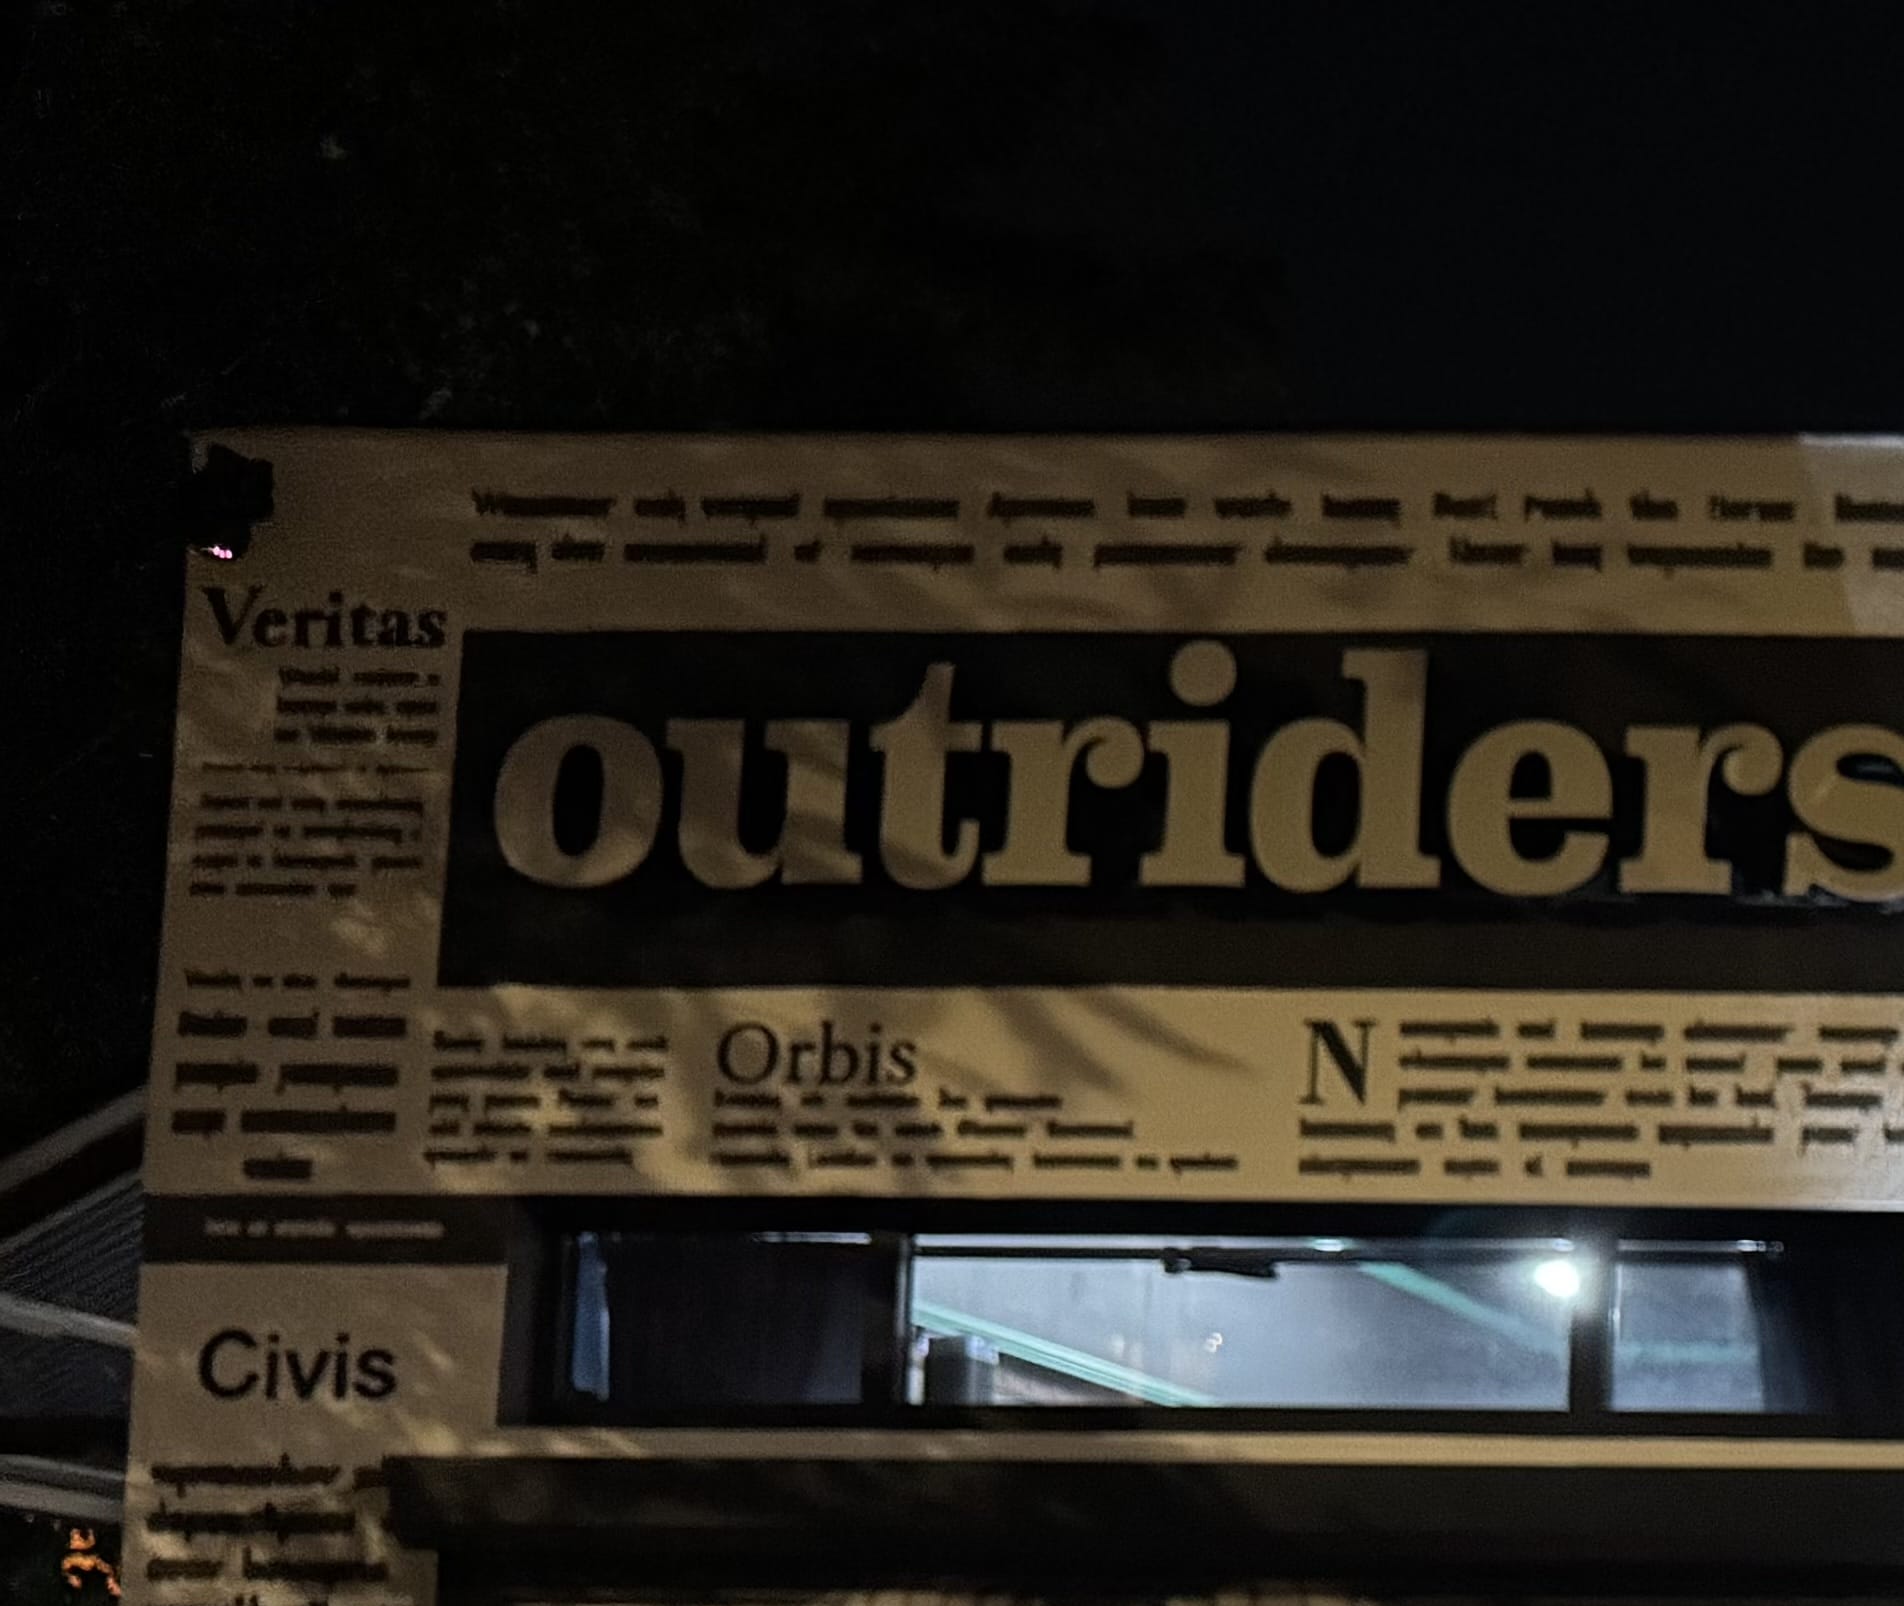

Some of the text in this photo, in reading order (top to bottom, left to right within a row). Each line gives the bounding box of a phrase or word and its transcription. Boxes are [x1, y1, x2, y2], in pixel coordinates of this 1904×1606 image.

[200, 585, 448, 650] Veritas
[717, 1019, 916, 1087] Orbis
[1301, 1020, 1375, 1105] N
[198, 1328, 397, 1402] Civis
